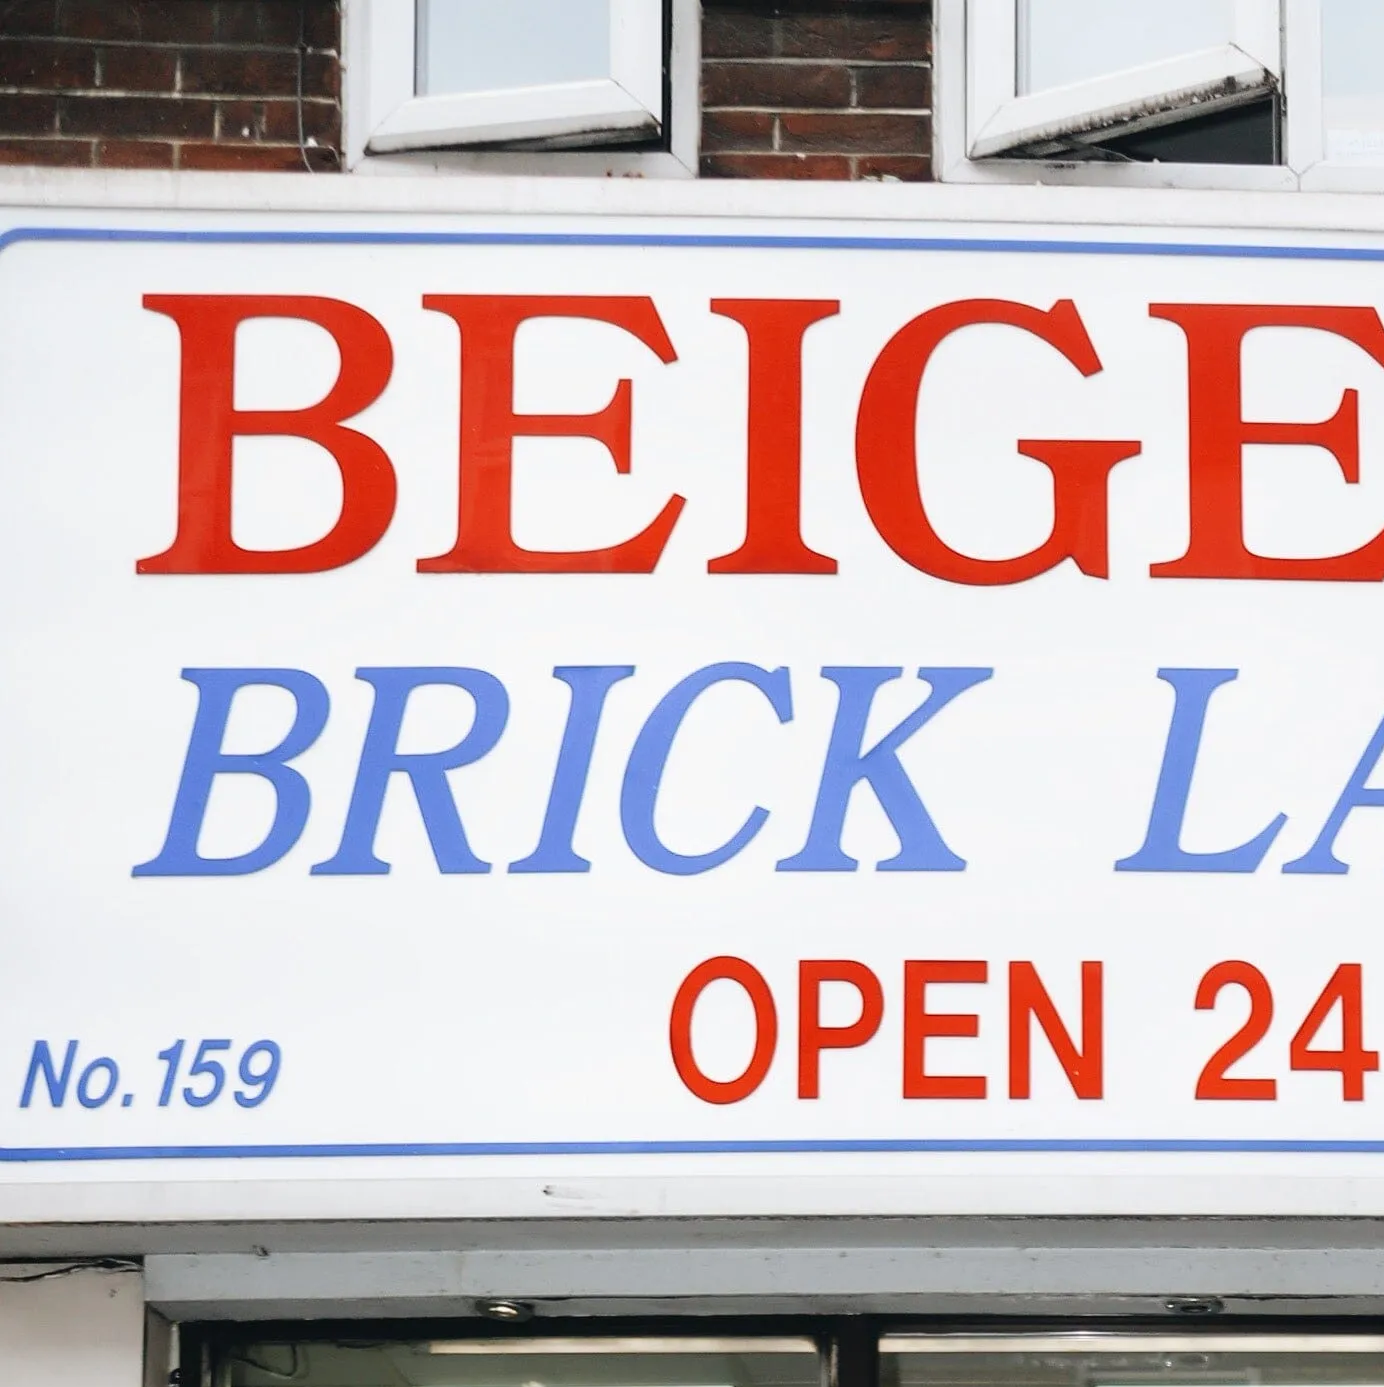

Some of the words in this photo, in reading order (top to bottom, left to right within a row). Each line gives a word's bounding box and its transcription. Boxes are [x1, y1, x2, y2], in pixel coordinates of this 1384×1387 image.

[131, 660, 994, 878] BRICK
[668, 955, 1104, 1105] OPEN
[1193, 959, 1381, 1102] 24
